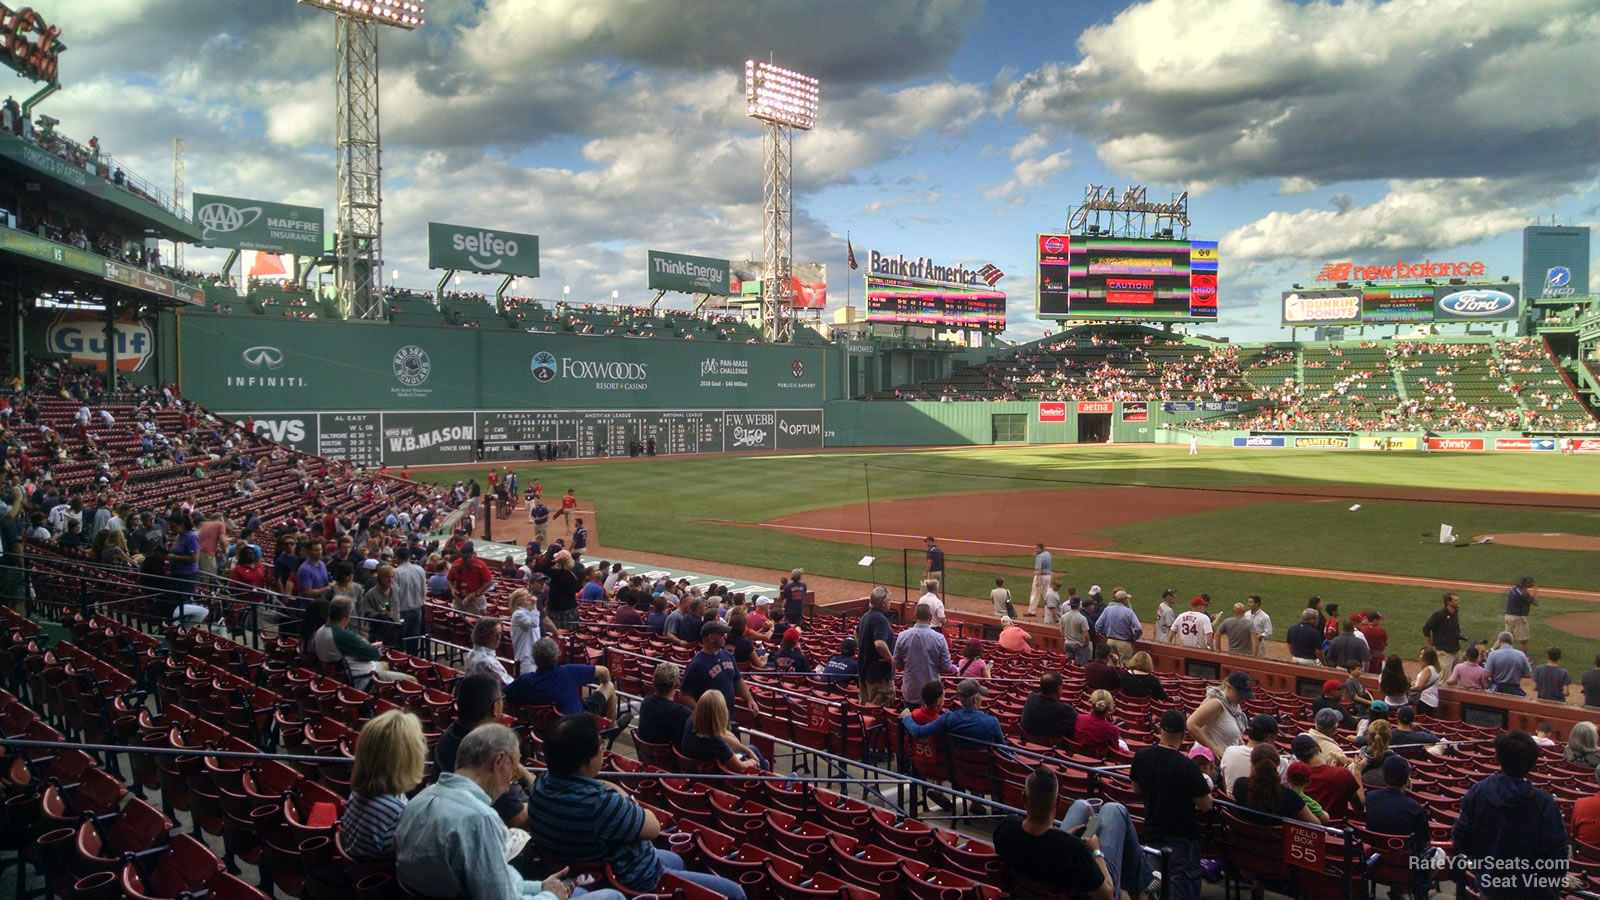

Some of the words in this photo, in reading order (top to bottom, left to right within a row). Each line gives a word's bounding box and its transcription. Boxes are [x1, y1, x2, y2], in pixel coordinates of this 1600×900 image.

[204, 206, 238, 230] AAA
[267, 217, 320, 232] MAPFRE
[270, 230, 318, 243] INSURANCE
[453, 232, 518, 258] selfeo
[653, 257, 722, 283] ThinkEnergy
[869, 250, 909, 277] Bank
[910, 256, 926, 278] of
[926, 258, 977, 286] America
[1354, 266, 1396, 281] new
[1397, 259, 1485, 279] balance
[1109, 281, 1153, 290] CAUTION!
[1305, 297, 1356, 310] DUNKIN'
[1453, 292, 1500, 313] Ford
[1305, 307, 1354, 319] DONUTS
[56, 327, 146, 354] Gulf
[562, 357, 648, 380] FOXWOODS
[720, 359, 748, 368] PAN-MASS
[720, 367, 748, 375] CHALLENGE
[595, 382, 619, 390] RESORT
[624, 383, 648, 391] CASINO
[1083, 403, 1108, 413] aetna
[1123, 406, 1147, 414] Safelite
[726, 415, 743, 426] F.W.
[745, 415, 774, 426] WEBB
[253, 419, 305, 442] CVS
[789, 424, 821, 435] OPTUM
[1246, 437, 1273, 447] jetBlue
[1439, 440, 1471, 449] xfinity
[1182, 623, 1198, 636] 34
[811, 715, 825, 727] 57
[916, 743, 933, 757] 56
[1290, 826, 1318, 840] FIELD
[1294, 835, 1313, 845] BOX
[1290, 844, 1317, 863] 55
